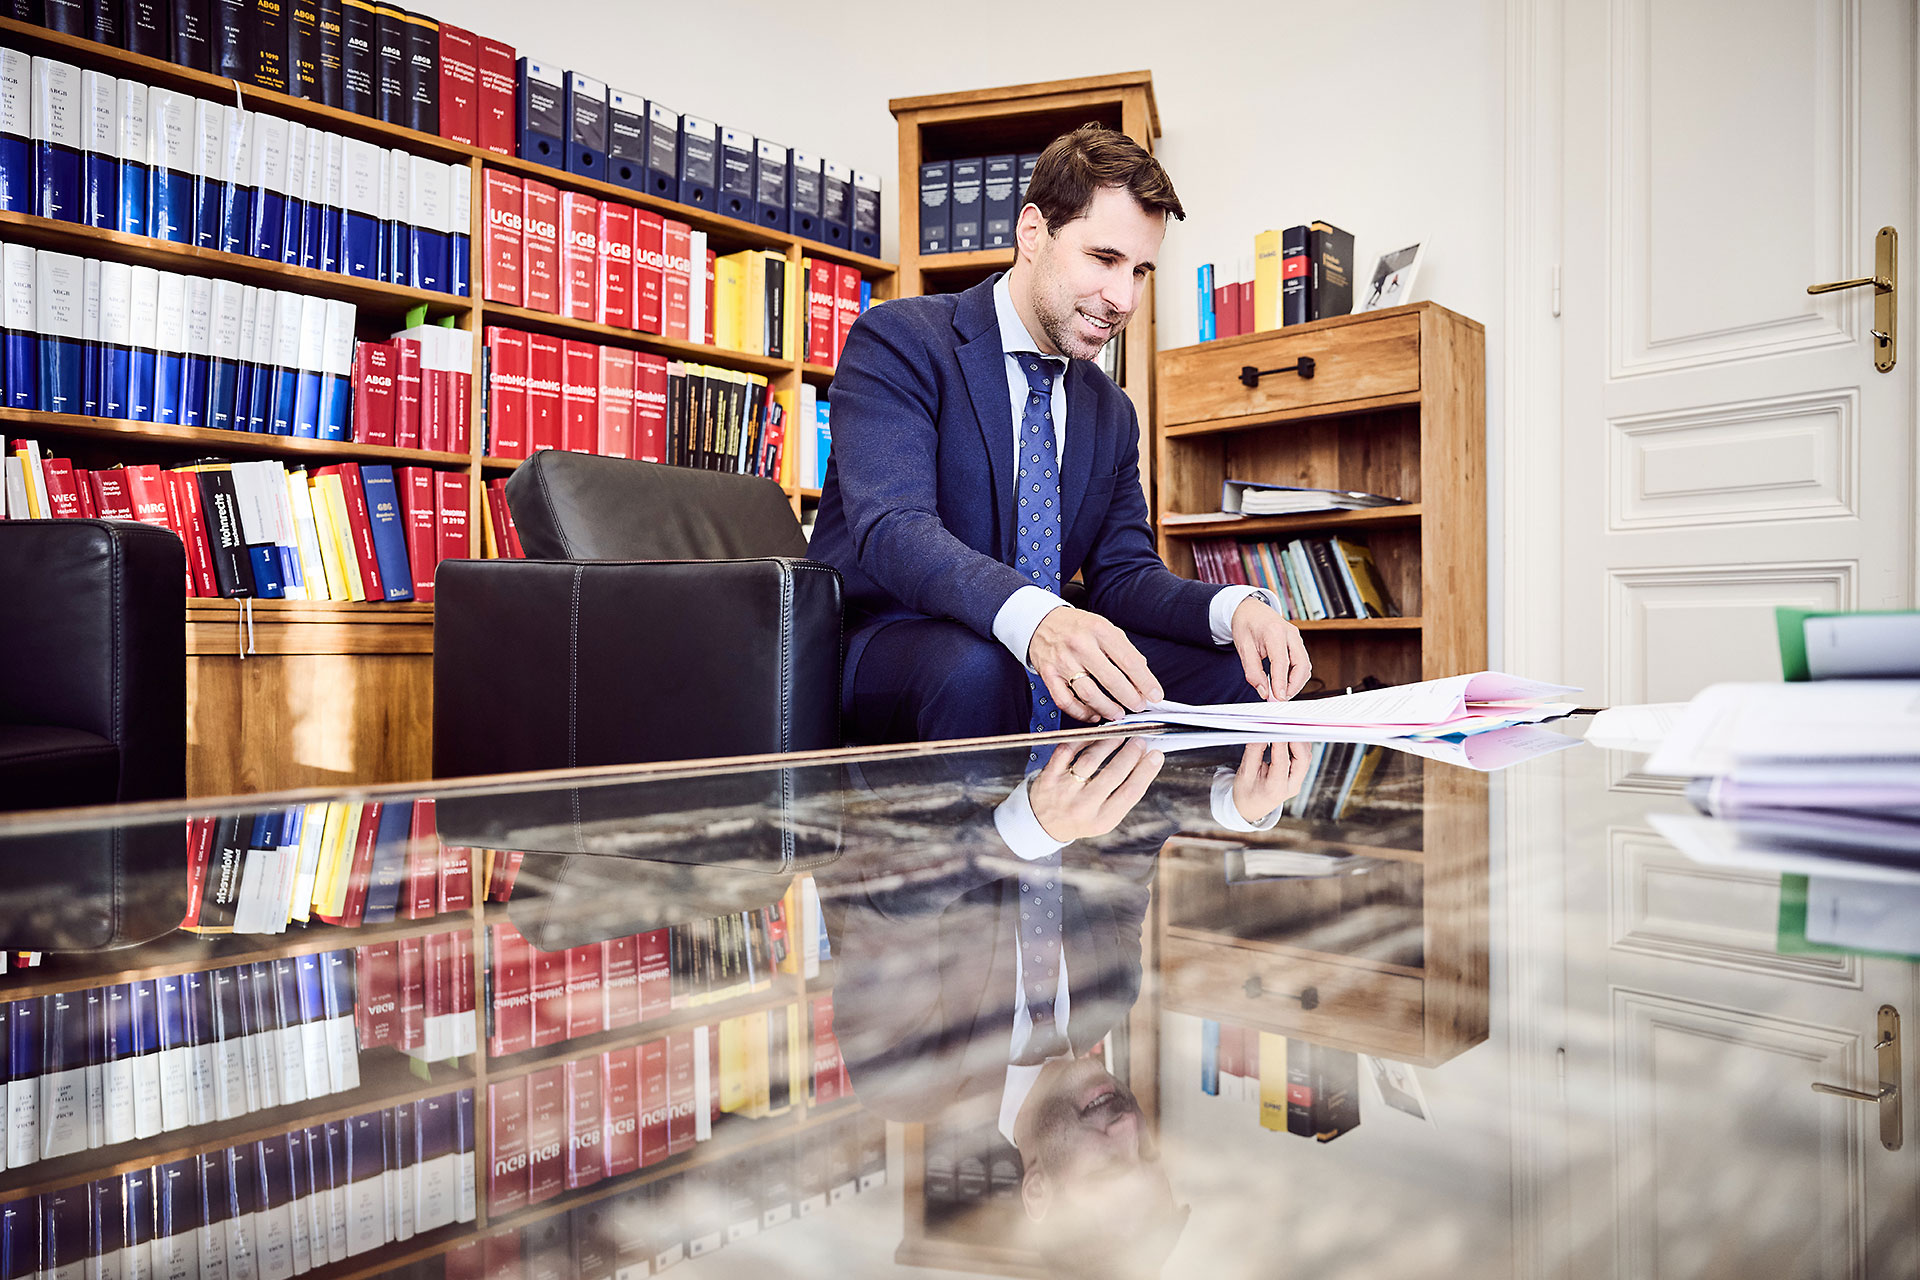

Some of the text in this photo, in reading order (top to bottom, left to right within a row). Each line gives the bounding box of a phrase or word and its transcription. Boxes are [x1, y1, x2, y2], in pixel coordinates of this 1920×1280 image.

[257, 0, 280, 12] ABGB
[294, 9, 315, 21] ABGB
[320, 21, 340, 32] ABGB
[349, 37, 368, 48] ABGB
[382, 46, 400, 56] ABGB
[413, 55, 431, 64] ABGB
[50, 88, 68, 96] ABGB
[491, 208, 522, 230] UGB
[525, 218, 555, 238] UGB
[564, 231, 596, 248] UGB
[599, 241, 631, 258] UGB
[637, 249, 663, 267] UGB
[664, 255, 692, 272] UGB
[810, 291, 833, 307] UWG
[365, 375, 392, 387] ABGB
[490, 372, 526, 387] GmbHG
[526, 378, 560, 391] GmbHG
[562, 384, 596, 397] GmbHG
[600, 386, 634, 398] GmbHG
[635, 390, 666, 403] GmbHG
[506, 404, 510, 412] 1
[578, 414, 583, 422] 3
[52, 494, 77, 503] WEG
[139, 504, 165, 514] MRG
[215, 493, 232, 548] Wohnrecht
